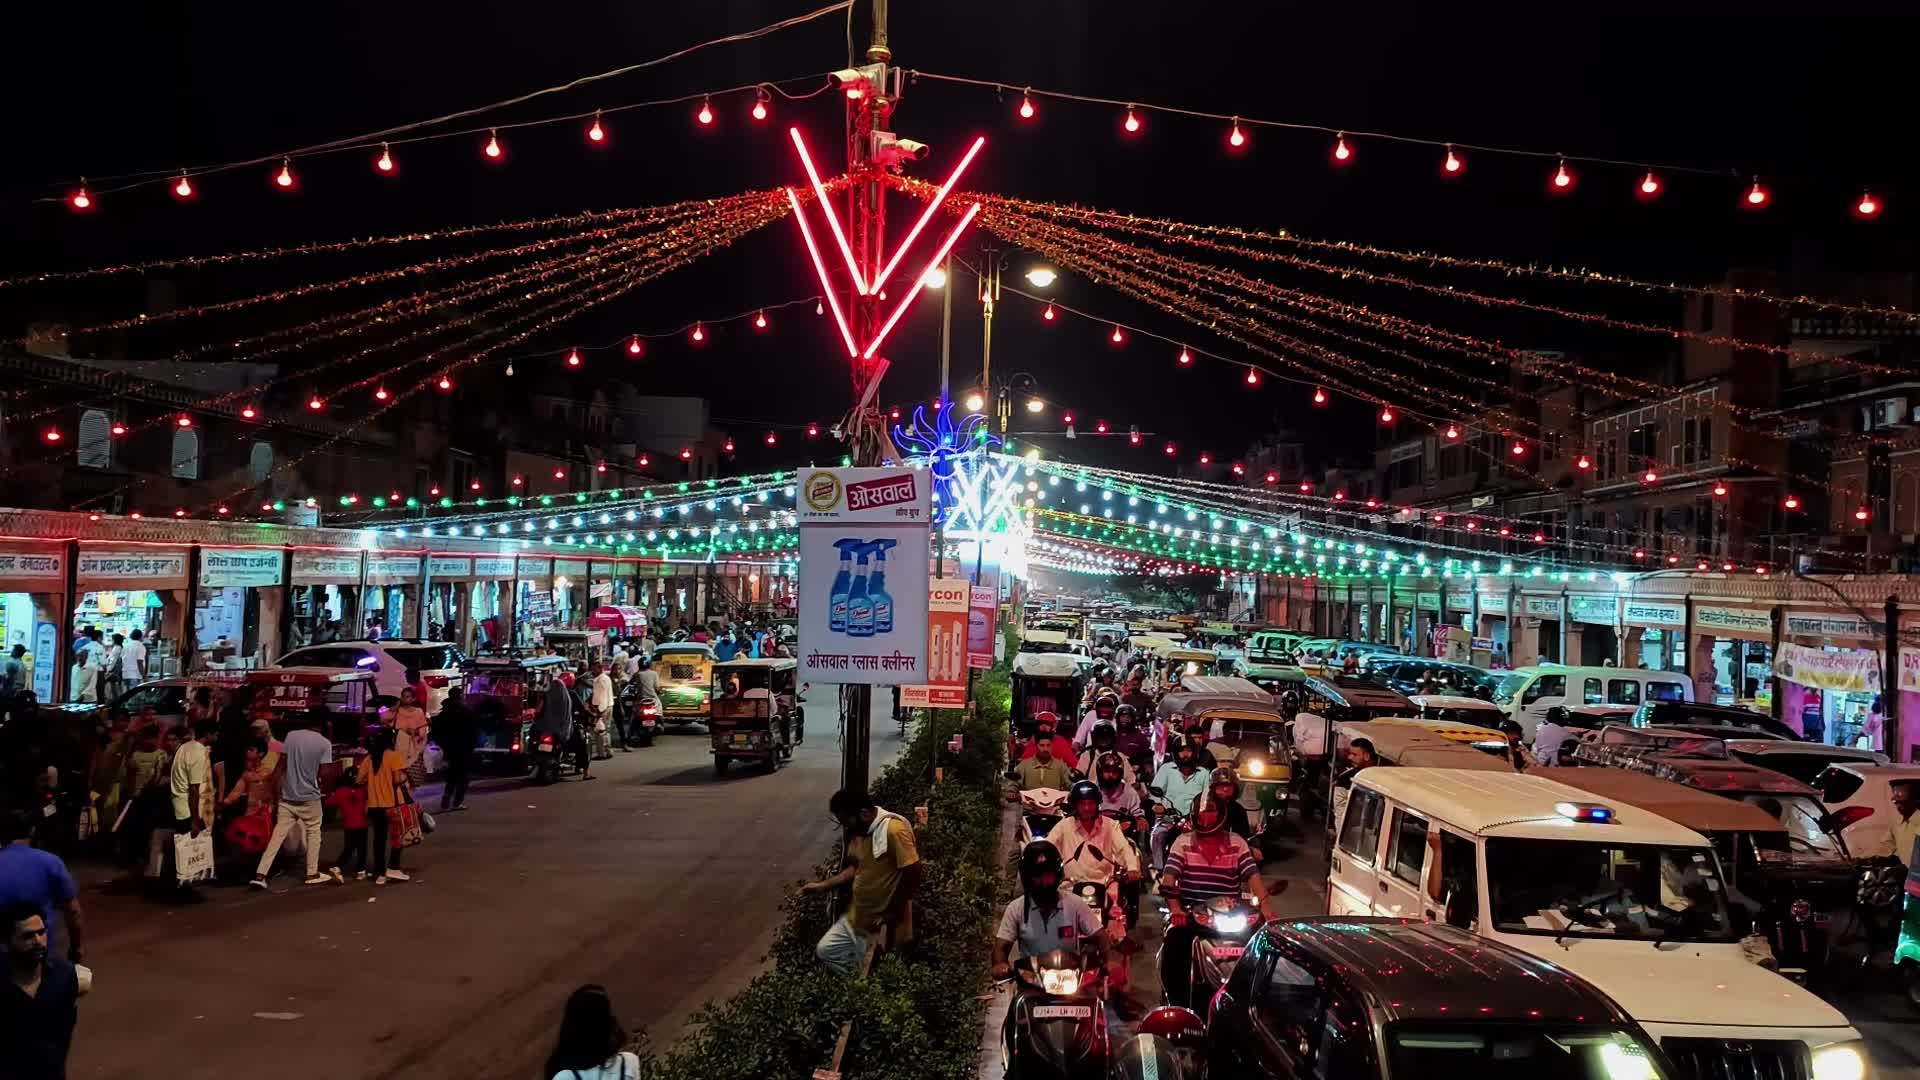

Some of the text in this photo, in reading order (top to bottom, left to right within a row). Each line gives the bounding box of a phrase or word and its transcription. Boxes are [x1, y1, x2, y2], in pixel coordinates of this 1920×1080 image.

[850, 481, 915, 508] ओसवाल
[806, 649, 916, 672] ओसवाल ग्लास क्लीनर
